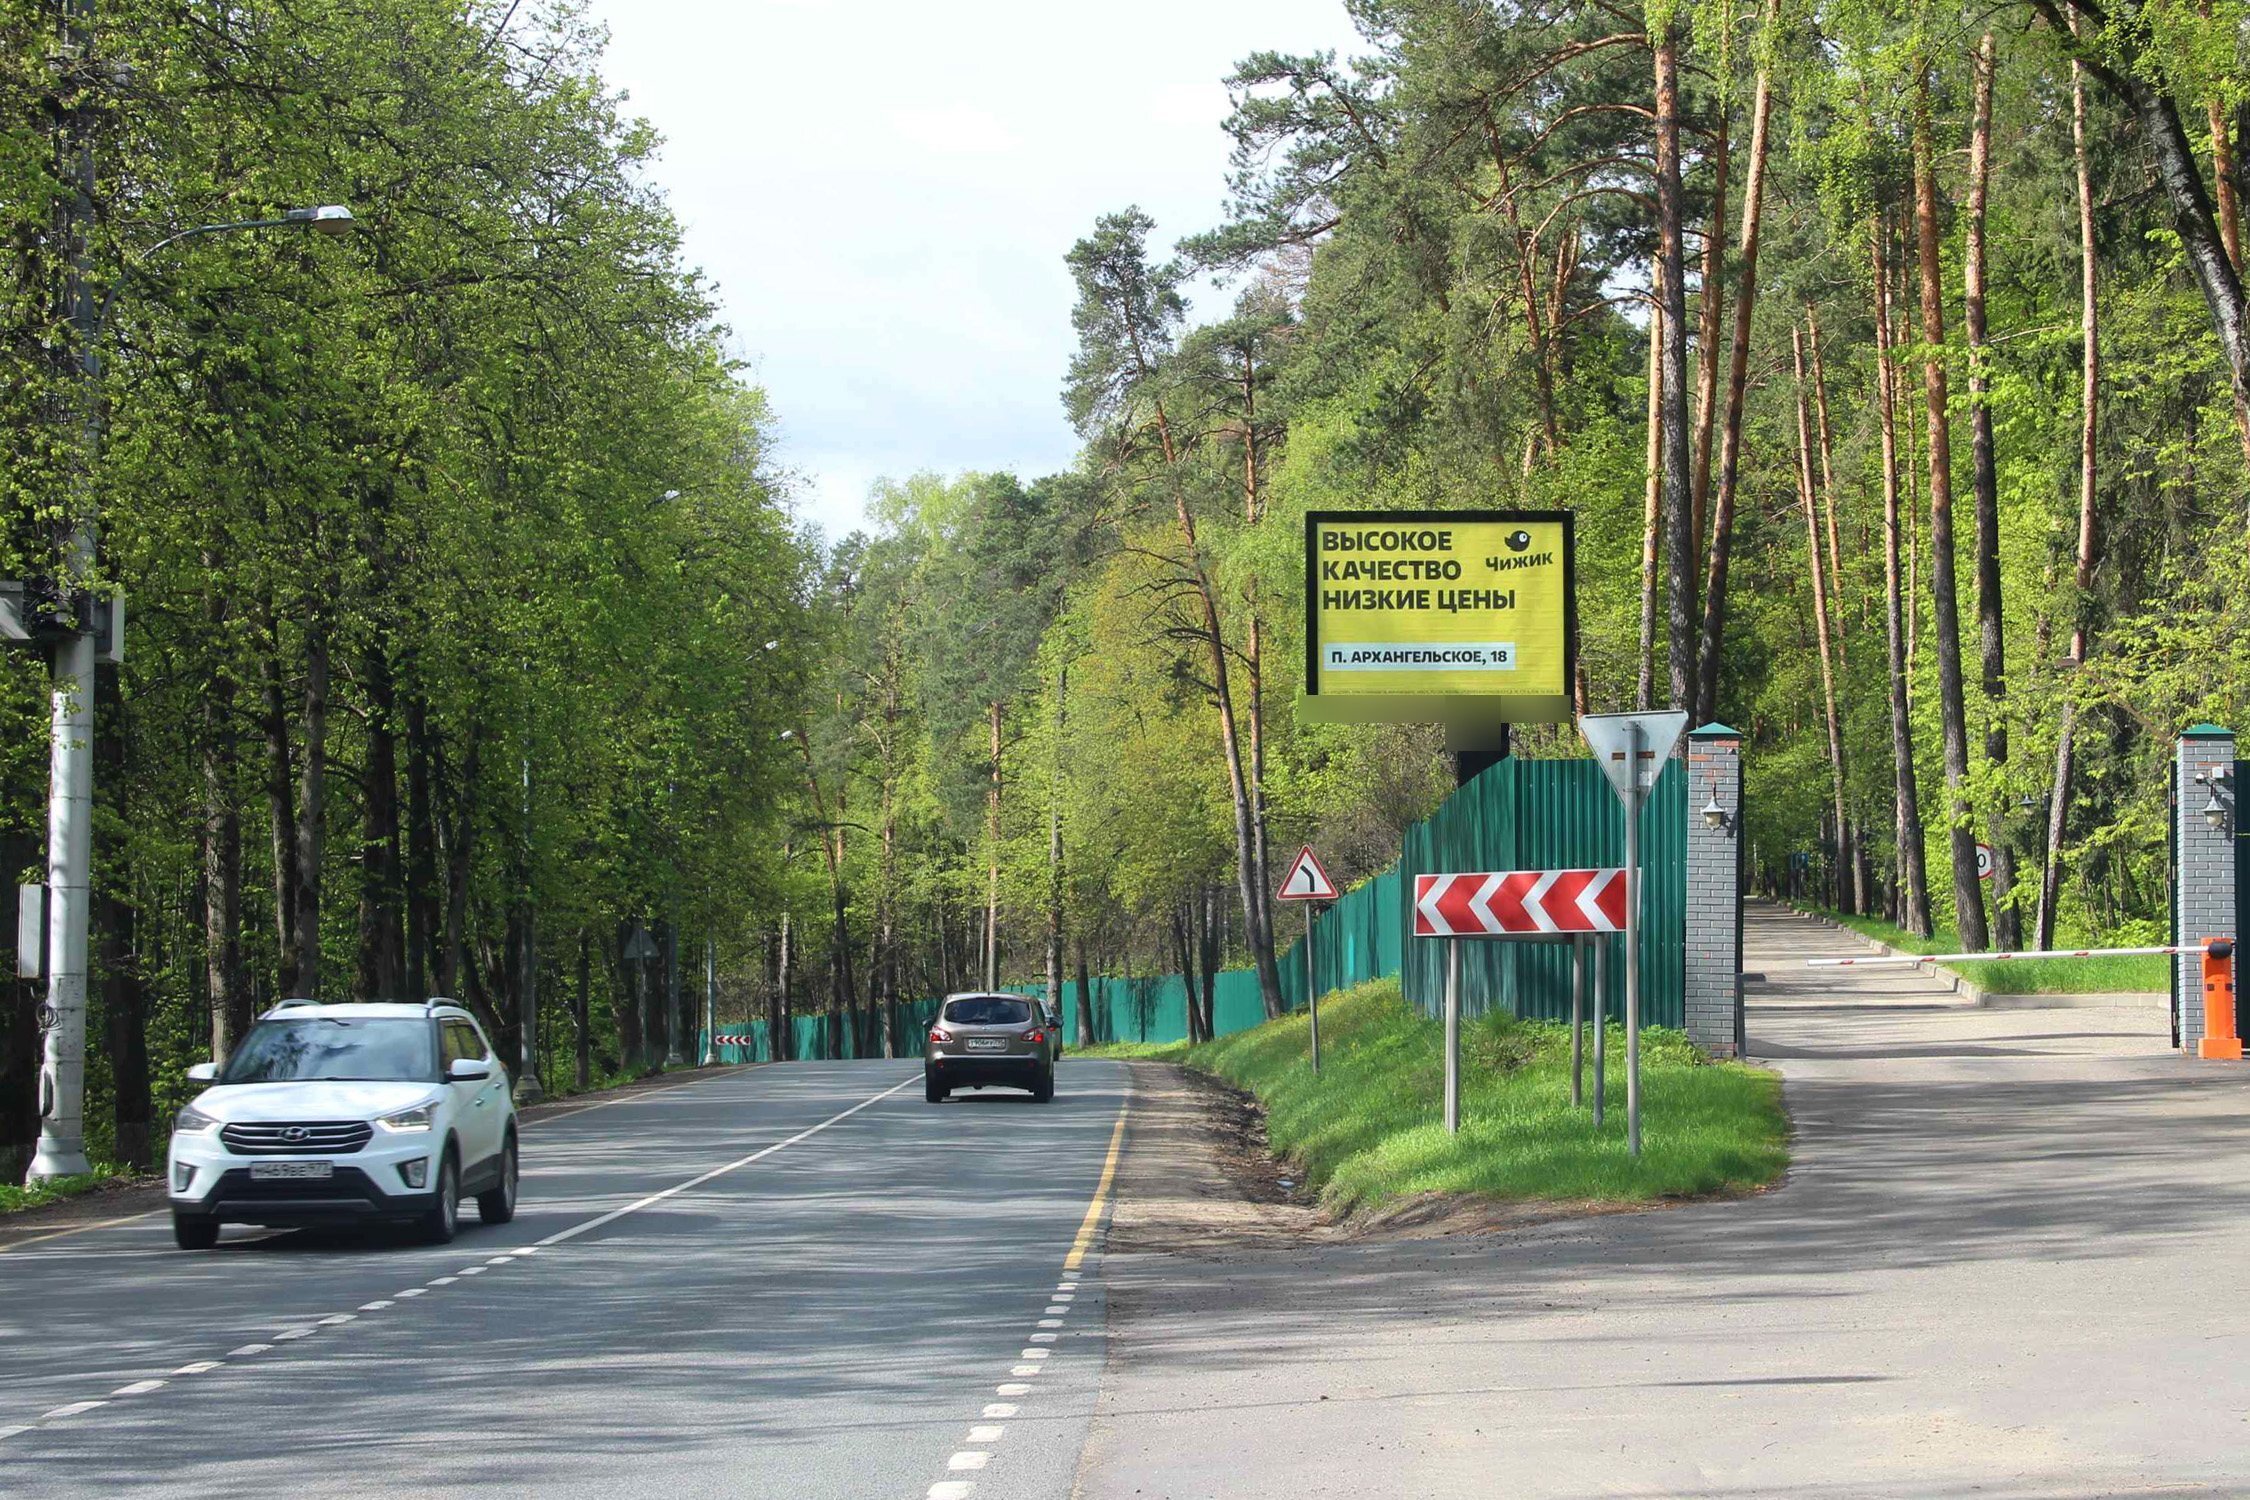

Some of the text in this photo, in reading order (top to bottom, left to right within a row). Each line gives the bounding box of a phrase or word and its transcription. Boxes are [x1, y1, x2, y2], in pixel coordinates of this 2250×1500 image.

[1322, 530, 1452, 551] ВЫСОКОЕ
[1322, 560, 1462, 581] КАЧЕСТВО
[1322, 589, 1515, 614] НИЗКИЕ ЦЕНЫ
[1331, 650, 1508, 666] П. АРХАНГЕЛЬСКОЕ, 18
